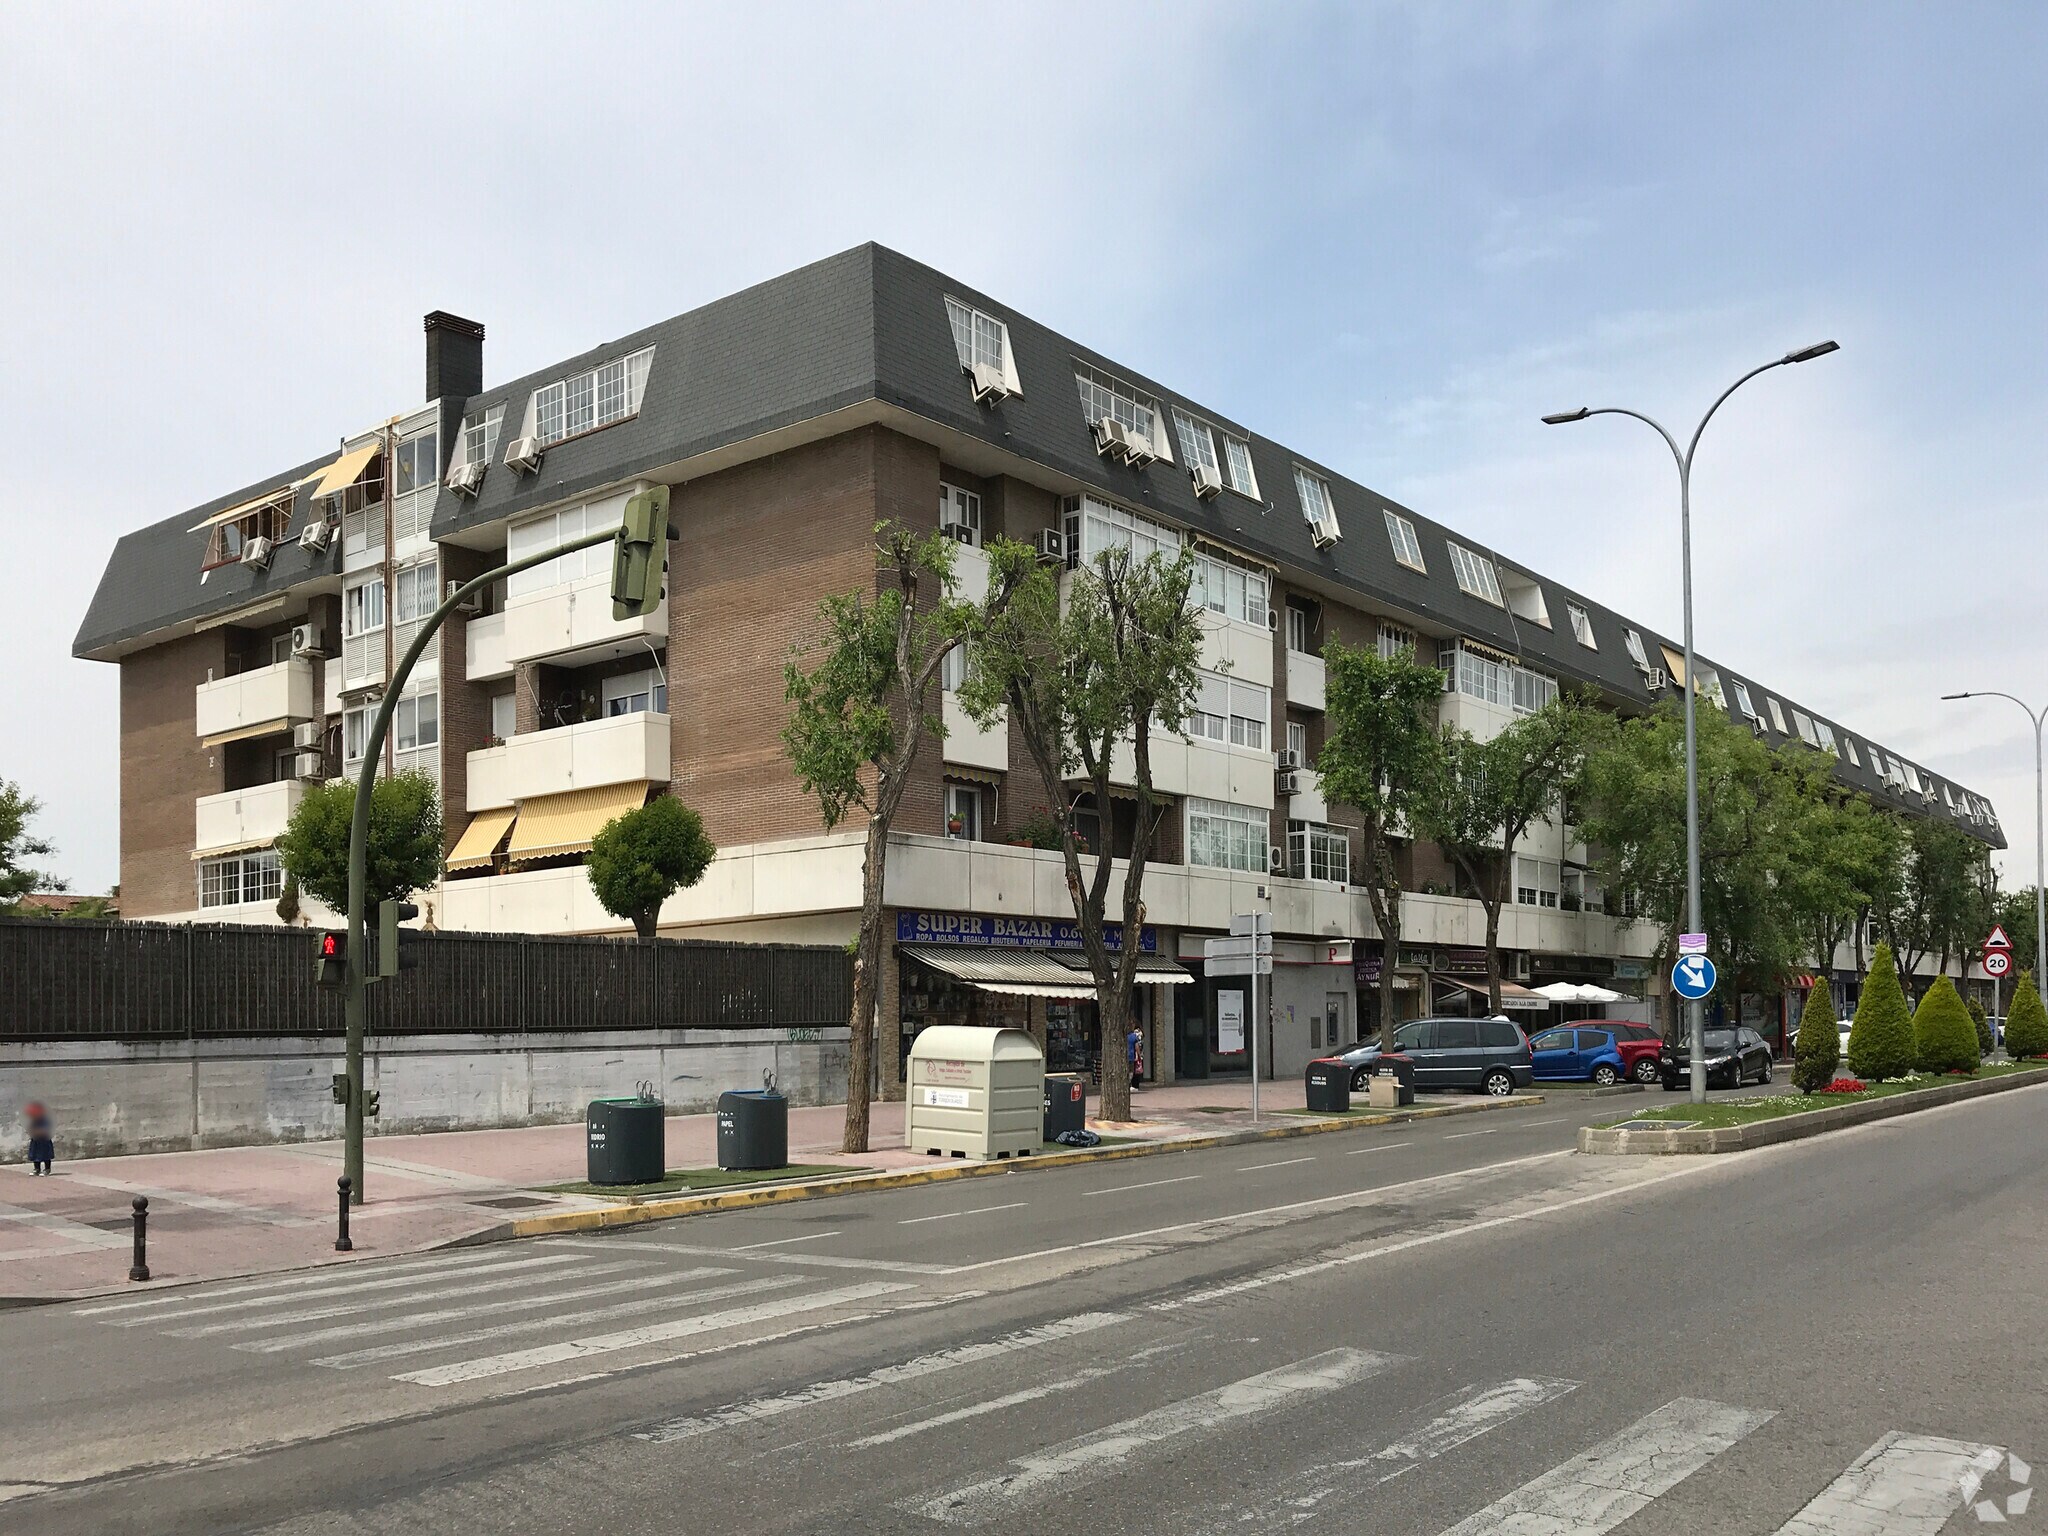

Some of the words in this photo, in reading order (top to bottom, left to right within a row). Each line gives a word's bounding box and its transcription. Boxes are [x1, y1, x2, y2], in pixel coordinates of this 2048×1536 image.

[916, 913, 982, 934] SUPER
[994, 918, 1052, 938] BAZAR
[916, 933, 933, 941] ROPA
[936, 934, 959, 942] BOLSOS
[962, 935, 989, 943] REGALOS
[991, 936, 1019, 945] BISUTERIA
[1022, 938, 1051, 946] PAPELERIA
[1328, 948, 1337, 960] P
[1989, 959, 2005, 968] 20
